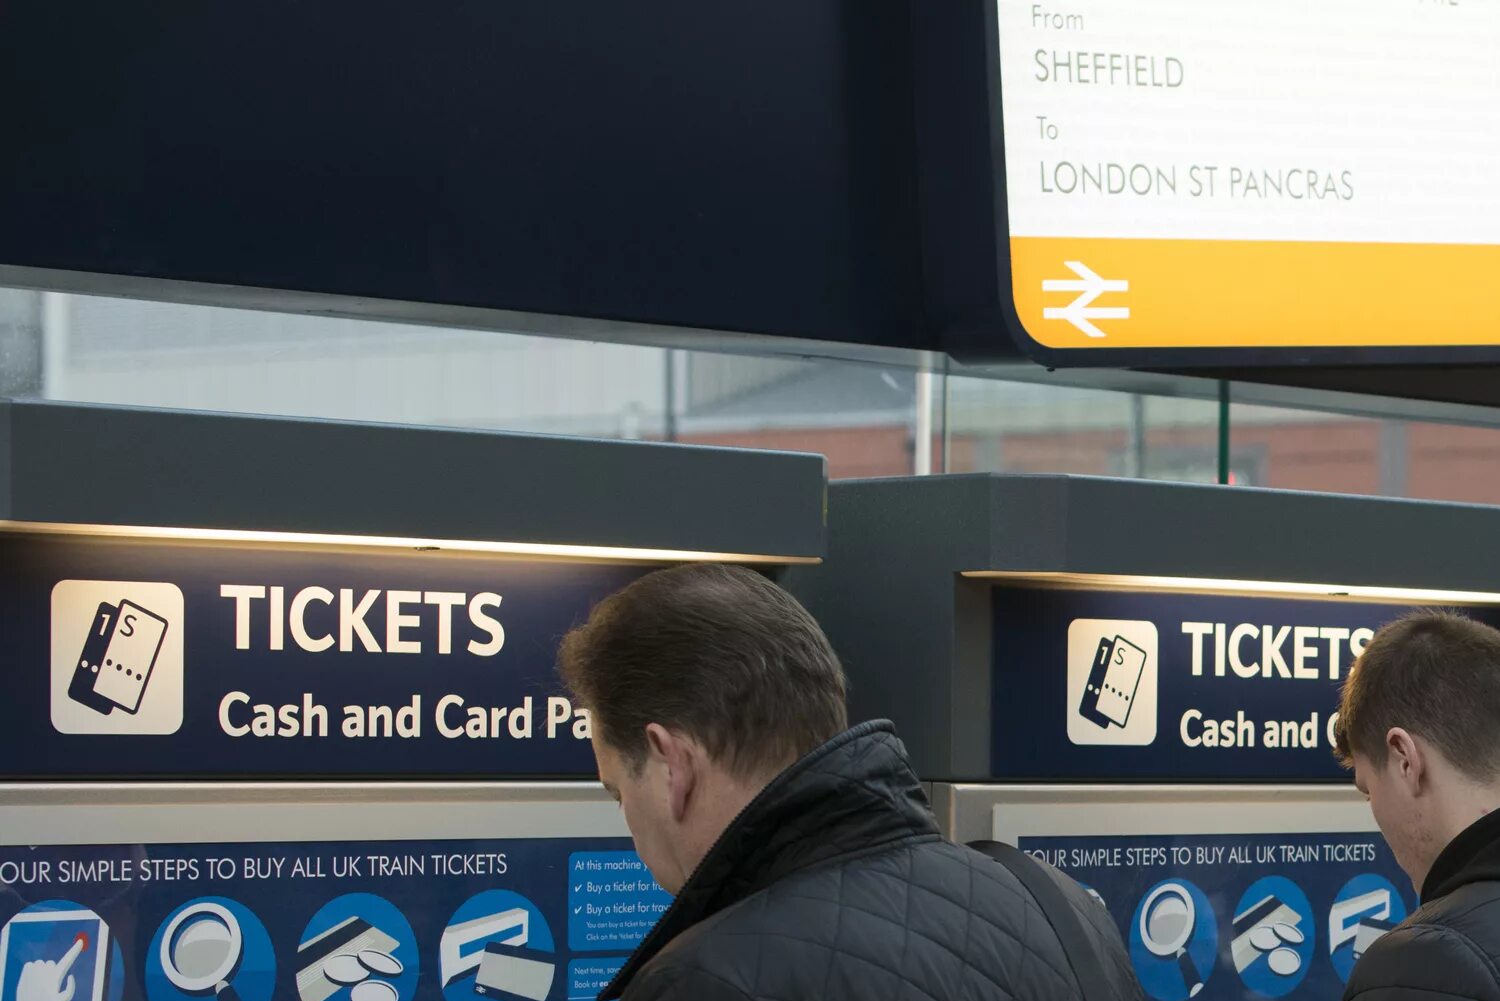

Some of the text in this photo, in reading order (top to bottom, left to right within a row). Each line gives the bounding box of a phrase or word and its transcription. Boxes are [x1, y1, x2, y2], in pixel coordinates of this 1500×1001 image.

[1032, 4, 1083, 30] From
[1035, 49, 1184, 87] SHEFFIELD
[1036, 116, 1058, 140] To
[1040, 161, 1354, 200] LONDON ST PANCRAS
[120, 614, 137, 637] S
[220, 584, 505, 657] TICKETS
[218, 691, 592, 740] Cash and Card Pa
[1180, 709, 1255, 748] Cash
[1264, 712, 1318, 748] and
[575, 860, 585, 871] At
[587, 860, 601, 870] this
[604, 857, 641, 870] machine
[1071, 844, 1375, 867] SIMPLE STEPS TO BUY ALL UK TRAIN TICKETS
[58, 860, 132, 882] SIMPLE
[139, 859, 200, 881] STEPS
[206, 858, 236, 879] TO
[244, 857, 285, 879] BUY
[291, 857, 326, 878] ALL
[333, 856, 361, 877] UK
[367, 855, 424, 876] TRAIN
[432, 854, 507, 875] TICKETS
[586, 882, 602, 894] Buy
[613, 881, 635, 892] ticket
[638, 880, 650, 891] for
[586, 904, 602, 915] Buy
[613, 903, 635, 914] ticket
[638, 902, 650, 913] for
[574, 967, 589, 975] Next
[574, 980, 590, 989] Book
